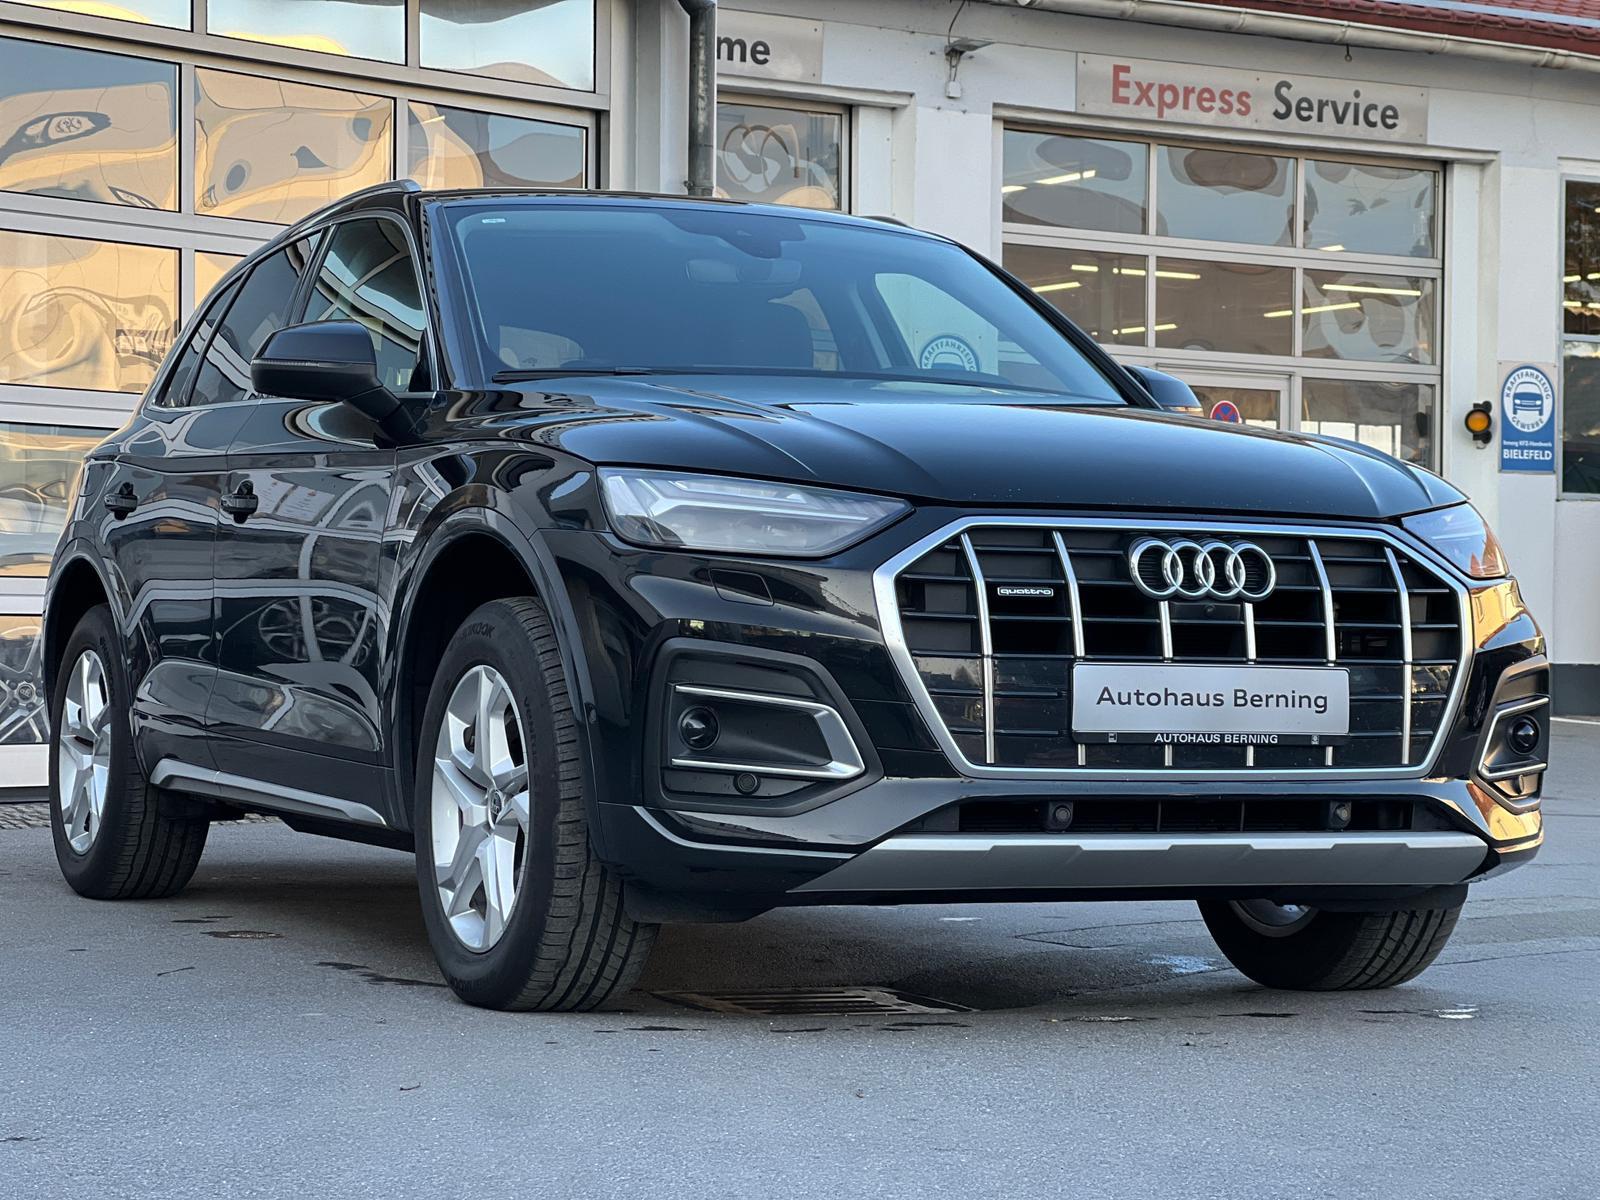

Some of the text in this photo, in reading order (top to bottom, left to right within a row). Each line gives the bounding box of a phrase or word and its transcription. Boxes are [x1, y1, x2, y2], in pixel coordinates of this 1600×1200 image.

[717, 36, 770, 65] me
[1111, 64, 1399, 130] Express Service
[1505, 371, 1552, 400] KRAFTFAHRZEUG
[1511, 416, 1544, 431] GEWERBE
[1503, 448, 1552, 460] BIELEFELD
[1000, 588, 1052, 596] quattro
[1096, 686, 1328, 714] Autohaus Berning
[1154, 733, 1278, 744] AUTOHAUS BERNING
